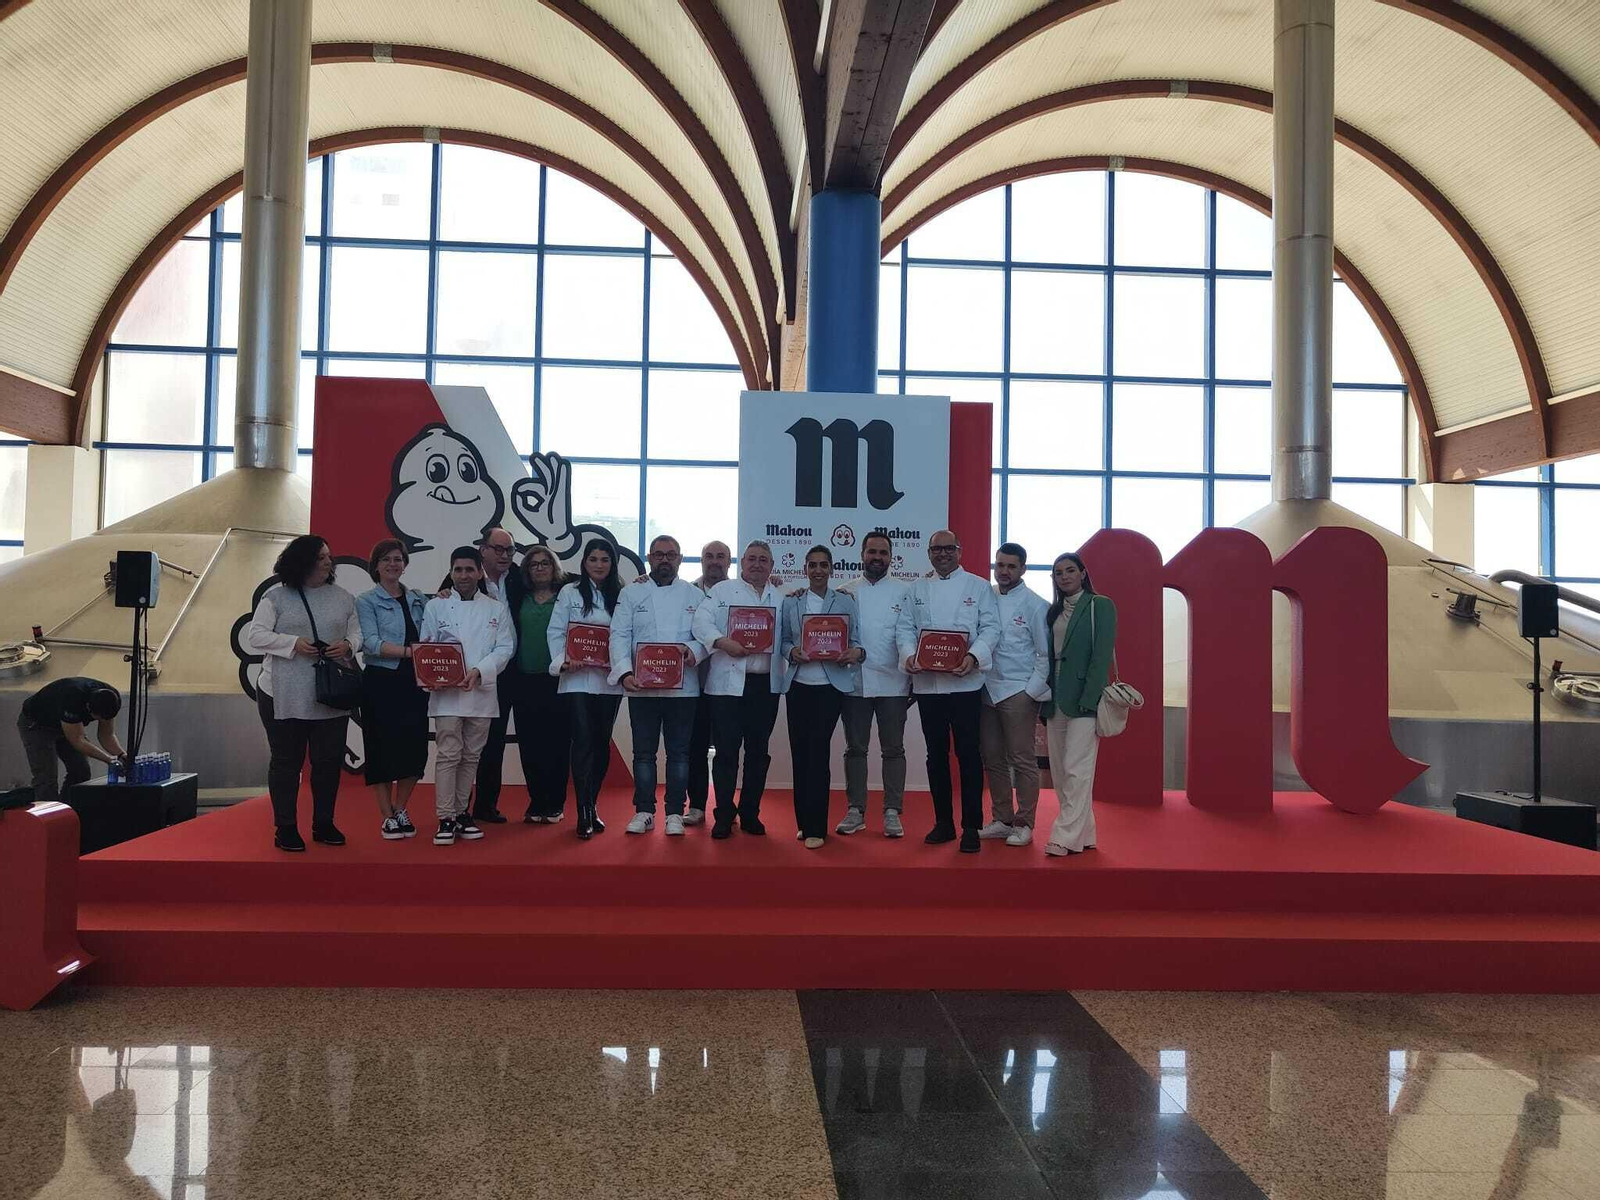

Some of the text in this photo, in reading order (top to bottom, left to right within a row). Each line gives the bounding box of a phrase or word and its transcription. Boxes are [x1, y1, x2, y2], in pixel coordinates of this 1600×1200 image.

[766, 524, 812, 537] Mahou
[833, 558, 865, 571] ahou
[573, 637, 607, 647] MICHELIN
[925, 644, 960, 652] MICHELIN
